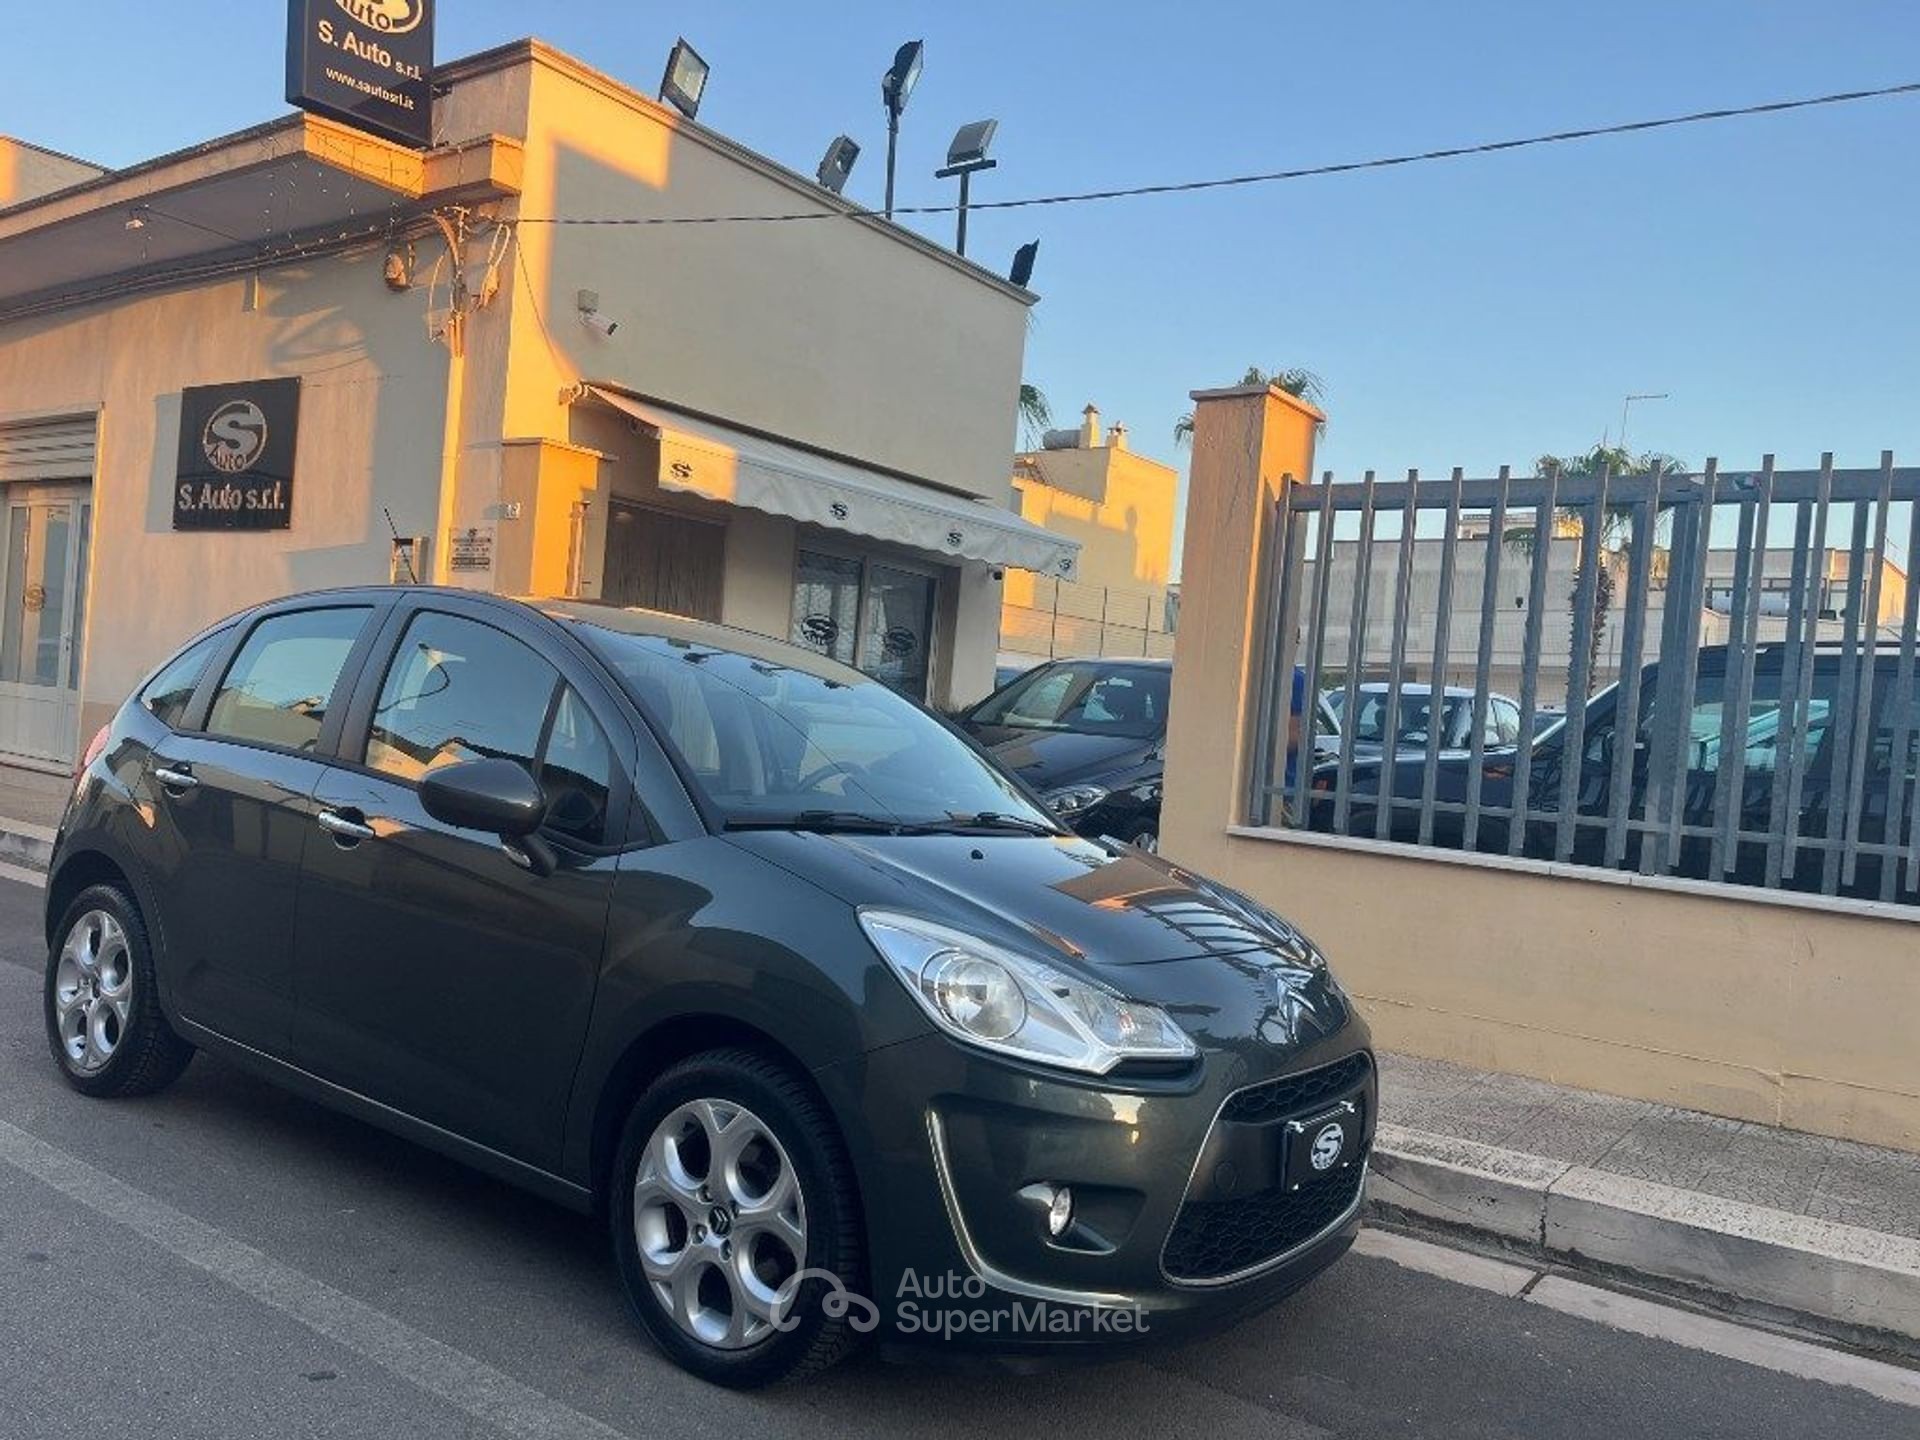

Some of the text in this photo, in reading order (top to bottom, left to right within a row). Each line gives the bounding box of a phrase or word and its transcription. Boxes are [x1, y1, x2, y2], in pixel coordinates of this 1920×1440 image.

[318, 19, 338, 47] S.
[343, 31, 391, 68] Auto
[326, 67, 415, 110] www.sautosrl.it
[179, 480, 284, 511] S. Auto s.r.l.
